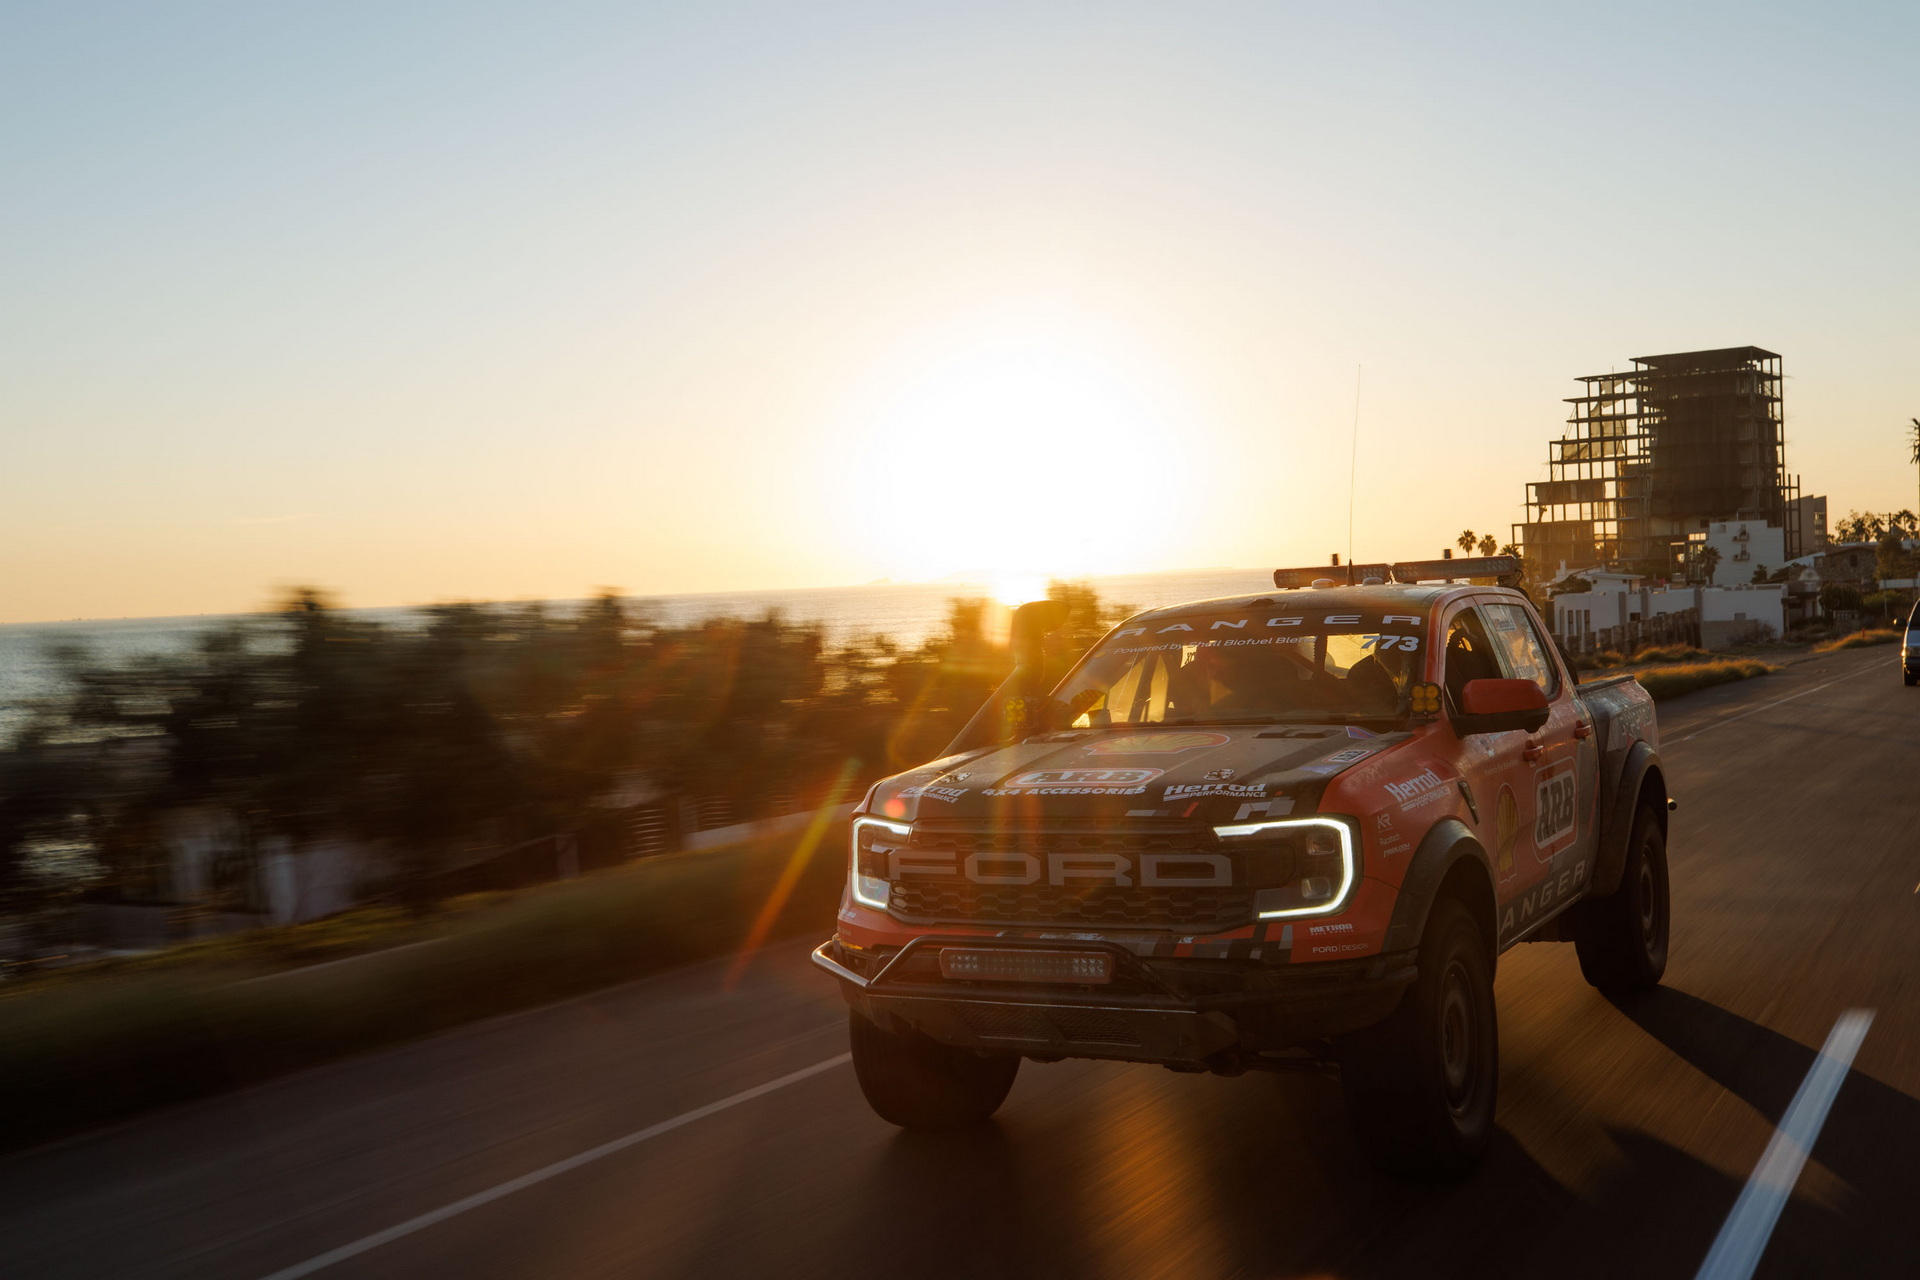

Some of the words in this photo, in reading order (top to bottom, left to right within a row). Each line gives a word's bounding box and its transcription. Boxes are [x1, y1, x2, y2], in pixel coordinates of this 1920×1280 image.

[1112, 614, 1422, 640] RANGER
[1113, 644, 1170, 655] Powered
[1171, 642, 1186, 652] by
[1188, 640, 1221, 649] Shell
[1224, 637, 1273, 647] Biofuel
[1360, 635, 1420, 652] 773
[1025, 786, 1148, 796] ACCESSORIES
[1164, 783, 1266, 796] Herrod
[1189, 789, 1268, 798] PERFORMANCE
[1383, 768, 1444, 803] Herrod
[1535, 775, 1575, 844] ARB
[888, 848, 1233, 887] FORD
[1499, 860, 1586, 937] ANGER
[1309, 923, 1354, 934] METHOD
[1312, 945, 1338, 954] FORD
[1341, 943, 1368, 951] DESIGN
